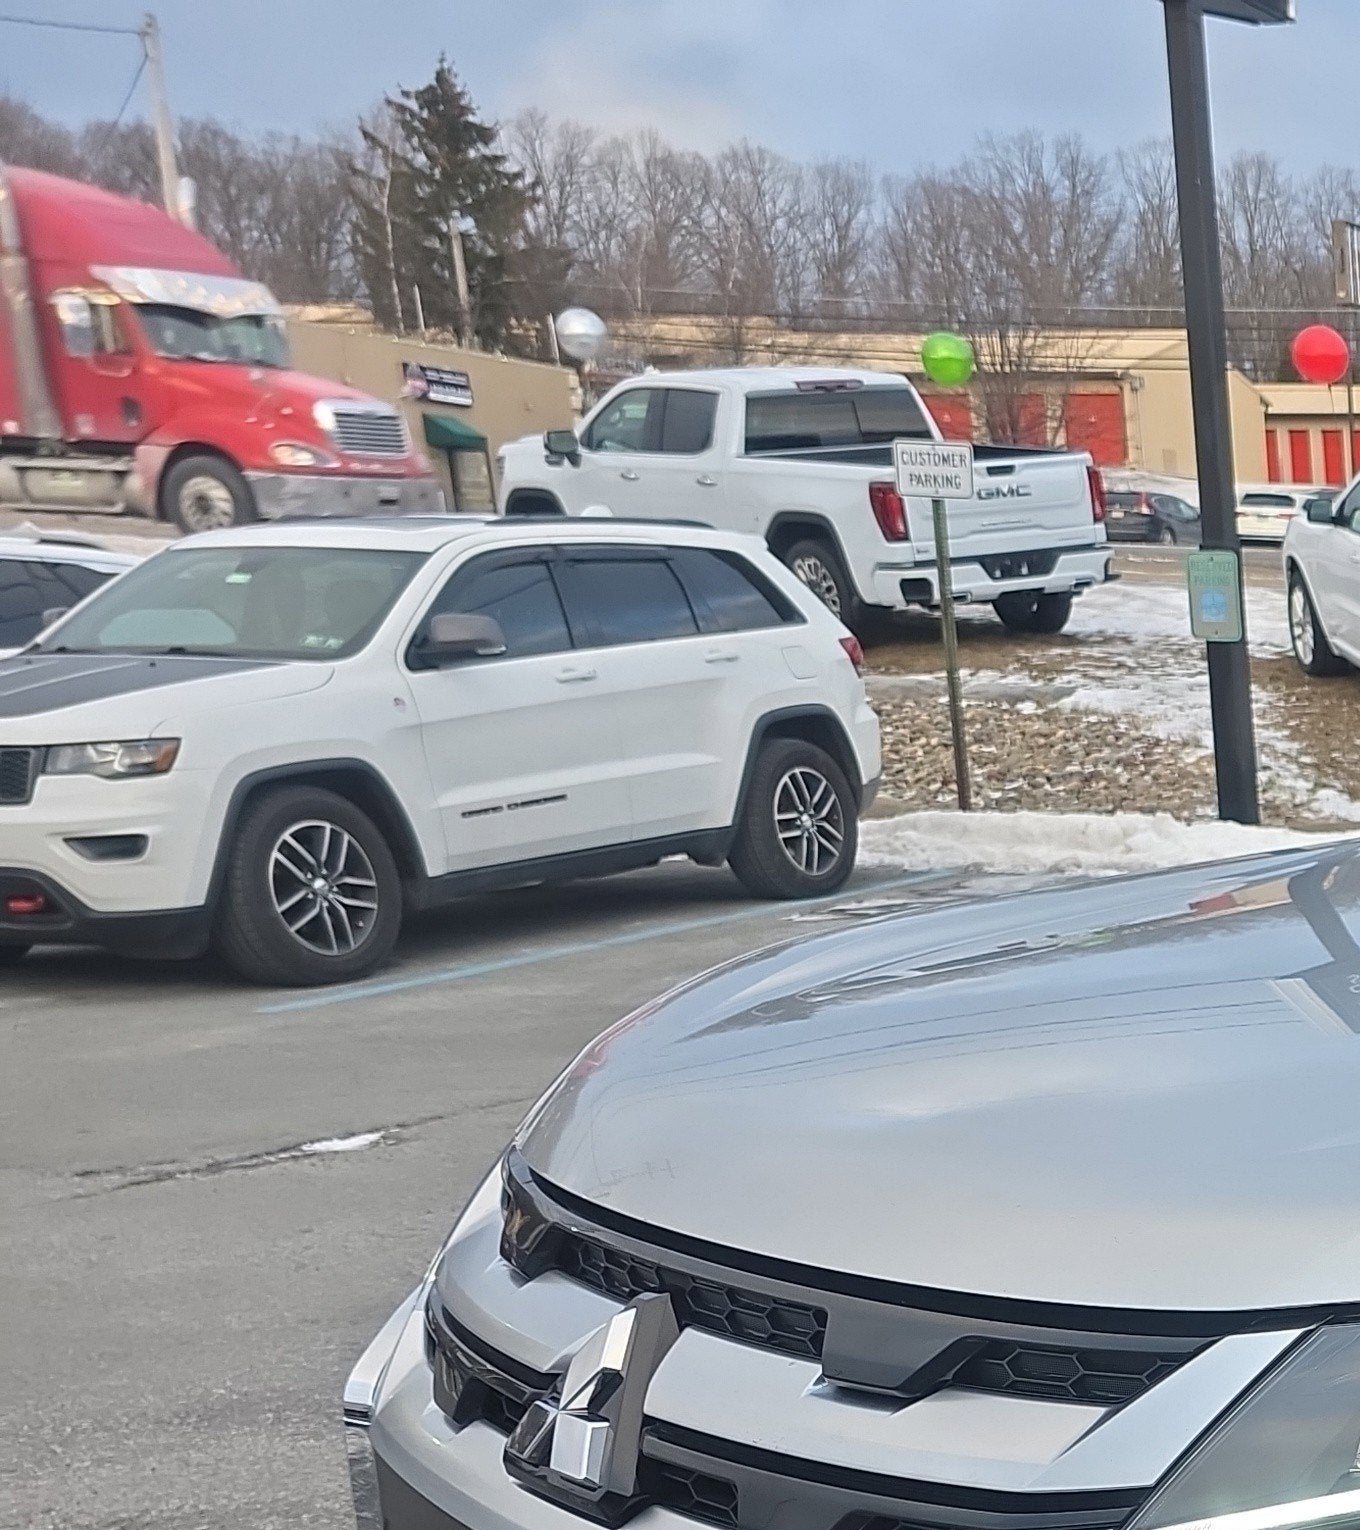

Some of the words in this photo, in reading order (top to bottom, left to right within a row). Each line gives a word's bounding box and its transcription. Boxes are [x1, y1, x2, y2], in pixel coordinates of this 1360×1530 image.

[901, 451, 967, 468] CUSTOMER
[910, 473, 962, 489] PARKING
[976, 485, 1032, 500] GMC
